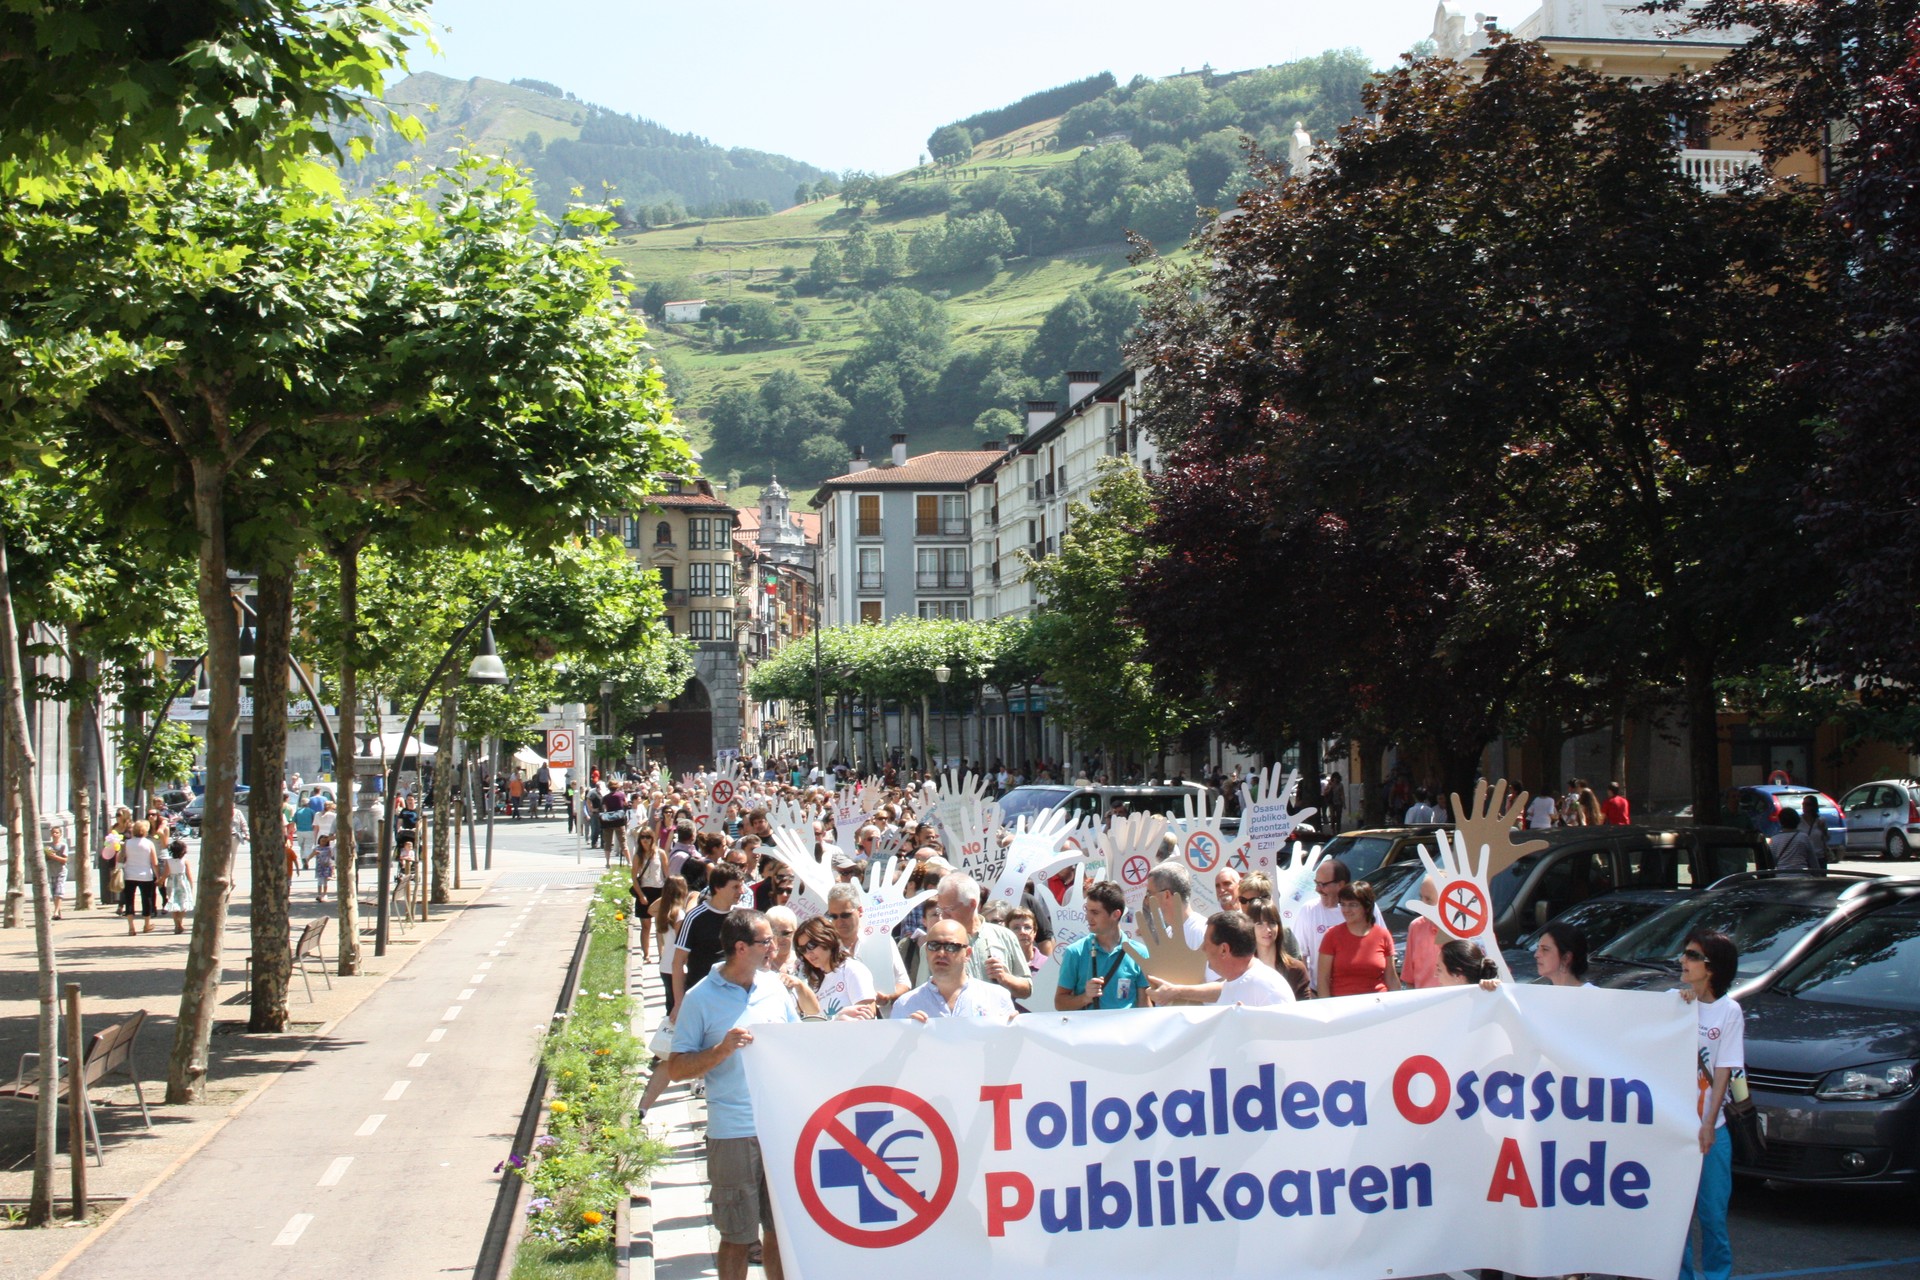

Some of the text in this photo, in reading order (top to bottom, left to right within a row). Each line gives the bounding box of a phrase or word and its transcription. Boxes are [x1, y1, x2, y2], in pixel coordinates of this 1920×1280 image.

[1252, 804, 1285, 814] Osasun
[1251, 813, 1287, 824] publikoa
[1248, 822, 1290, 833] denontzat
[1257, 841, 1275, 851] EZ!!!
[962, 857, 971, 868] A
[868, 909, 899, 919] defenda
[980, 1054, 1655, 1151] Tolosaldea Osasun
[984, 1136, 1652, 1238] Publikoaren Alde
